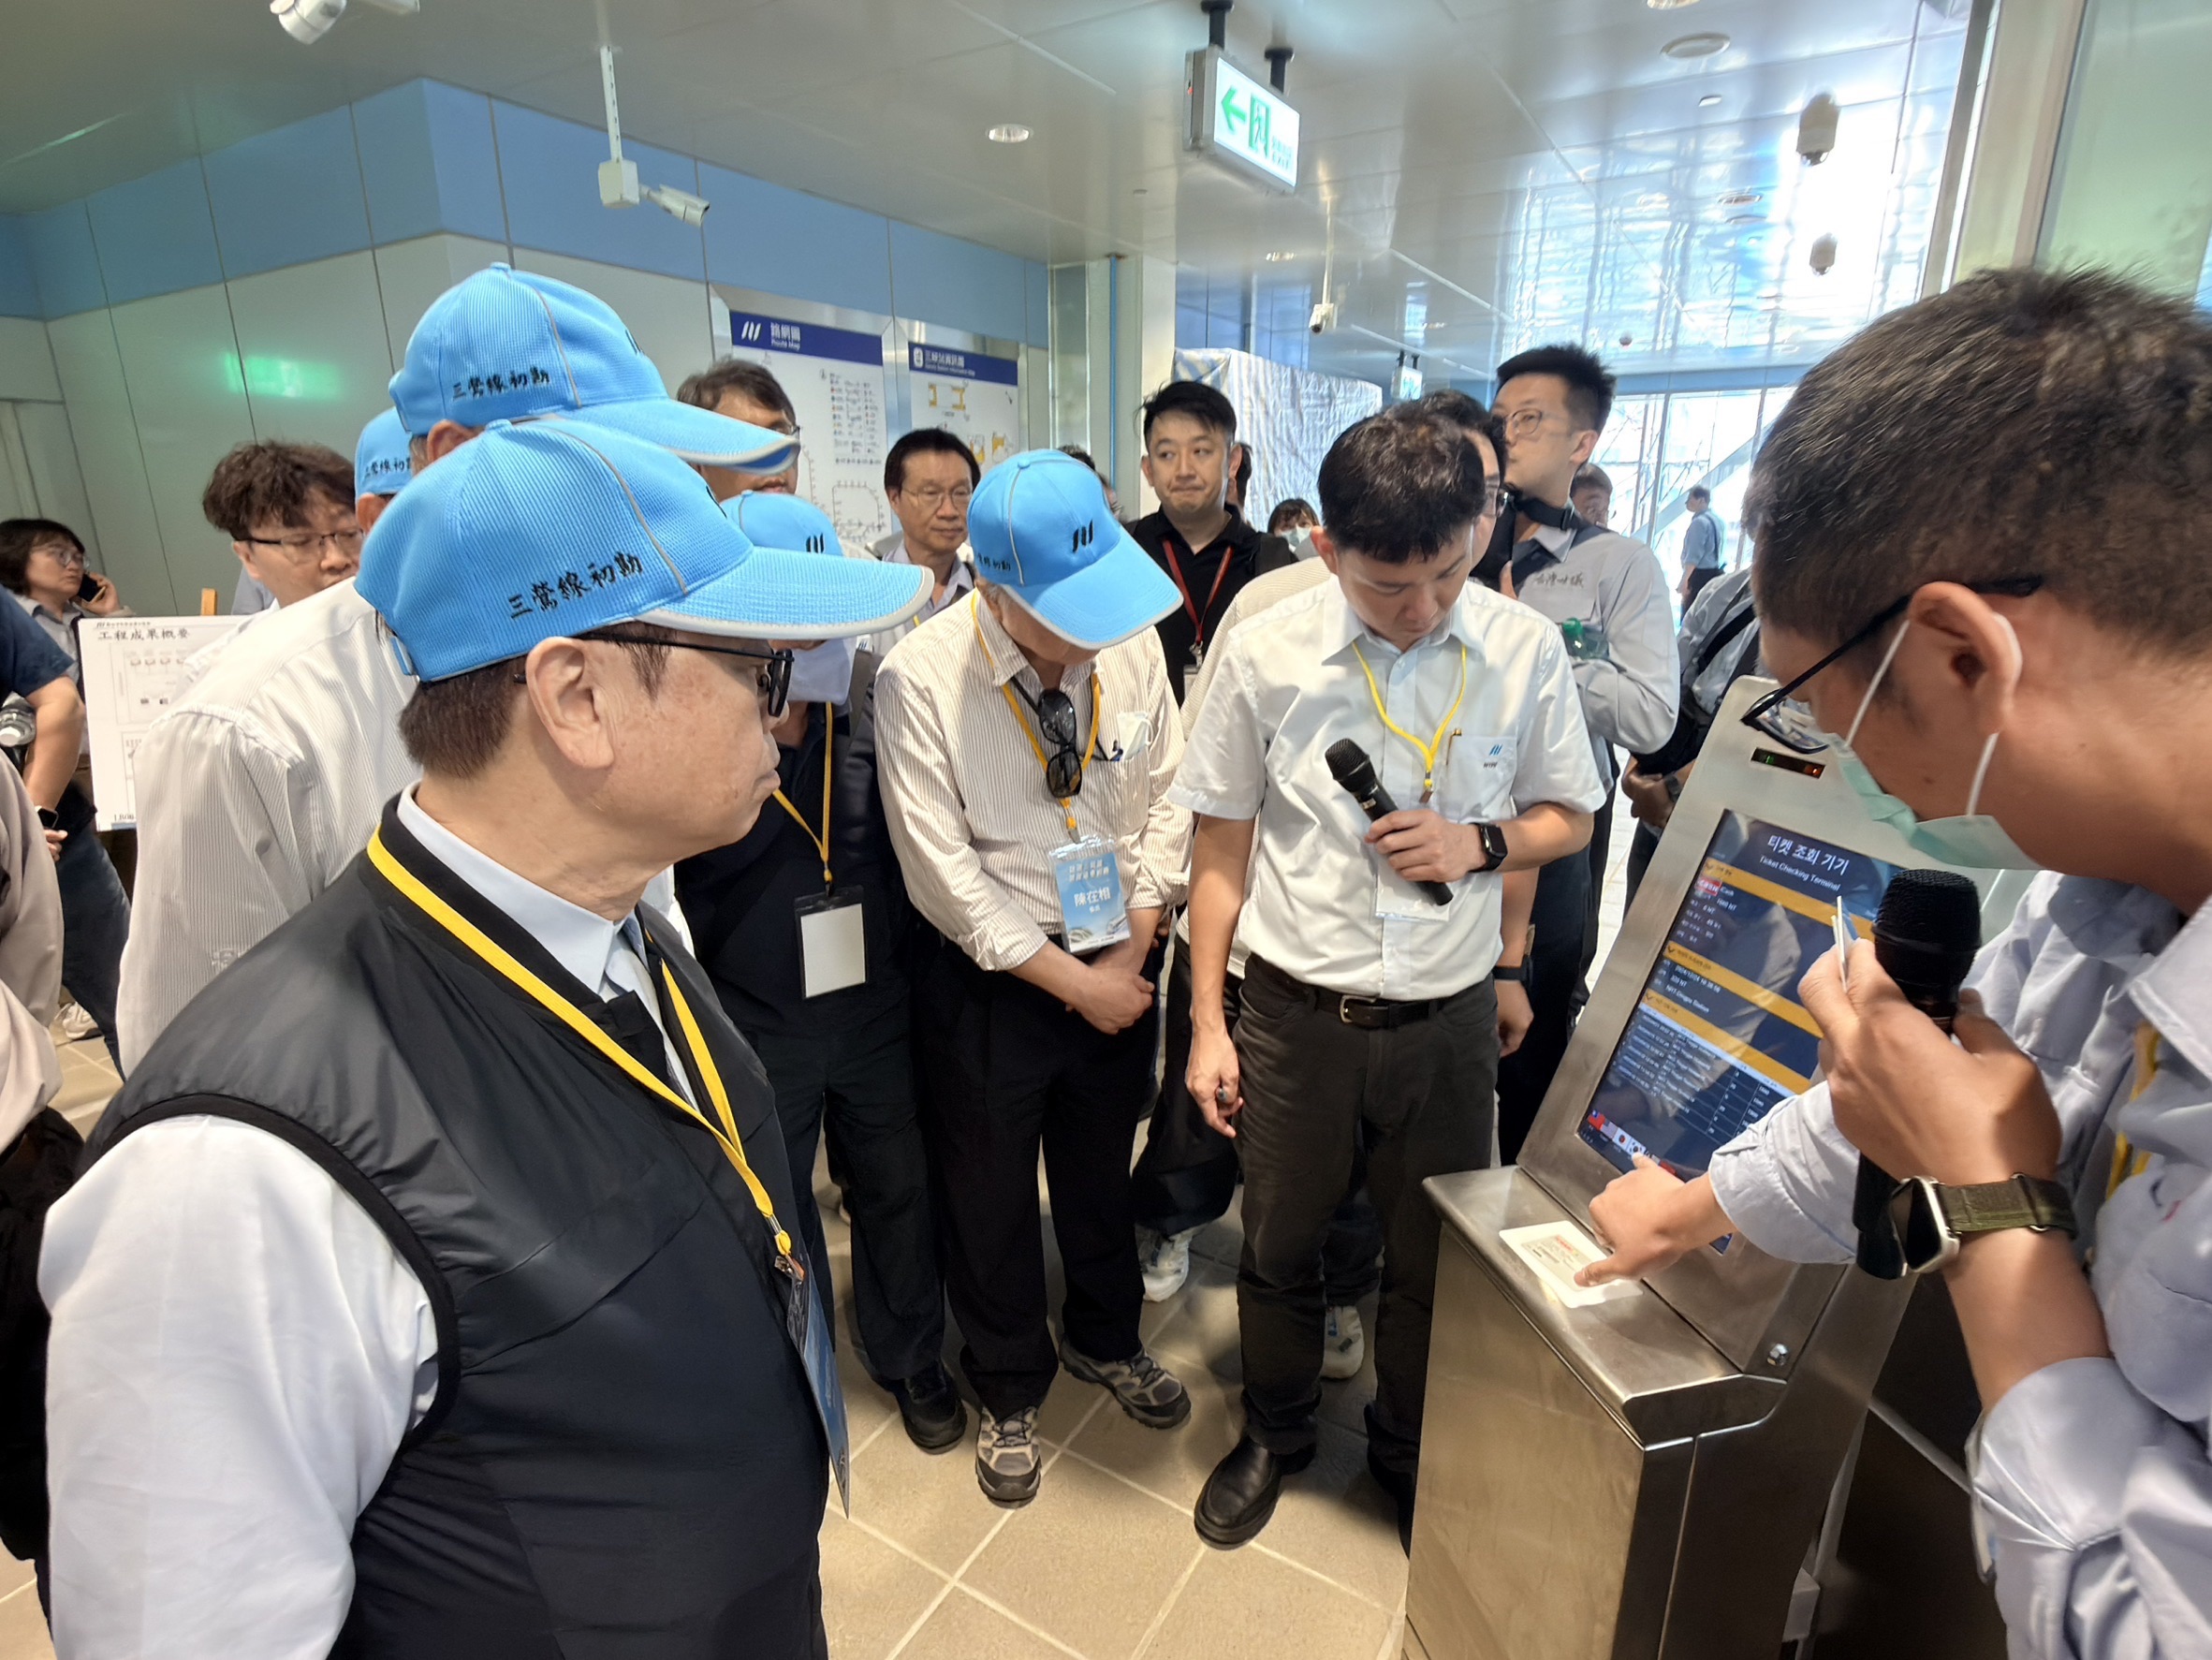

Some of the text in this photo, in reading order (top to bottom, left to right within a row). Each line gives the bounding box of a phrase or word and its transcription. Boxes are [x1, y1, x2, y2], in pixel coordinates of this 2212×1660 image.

[788, 341, 801, 351] Map
[508, 551, 644, 619] 三鶯線初勘
[97, 627, 189, 641] 工程成果概要
[1759, 855, 1841, 892] Ticket Checking Terminal
[1767, 834, 1850, 876] 티켓 조회 기기
